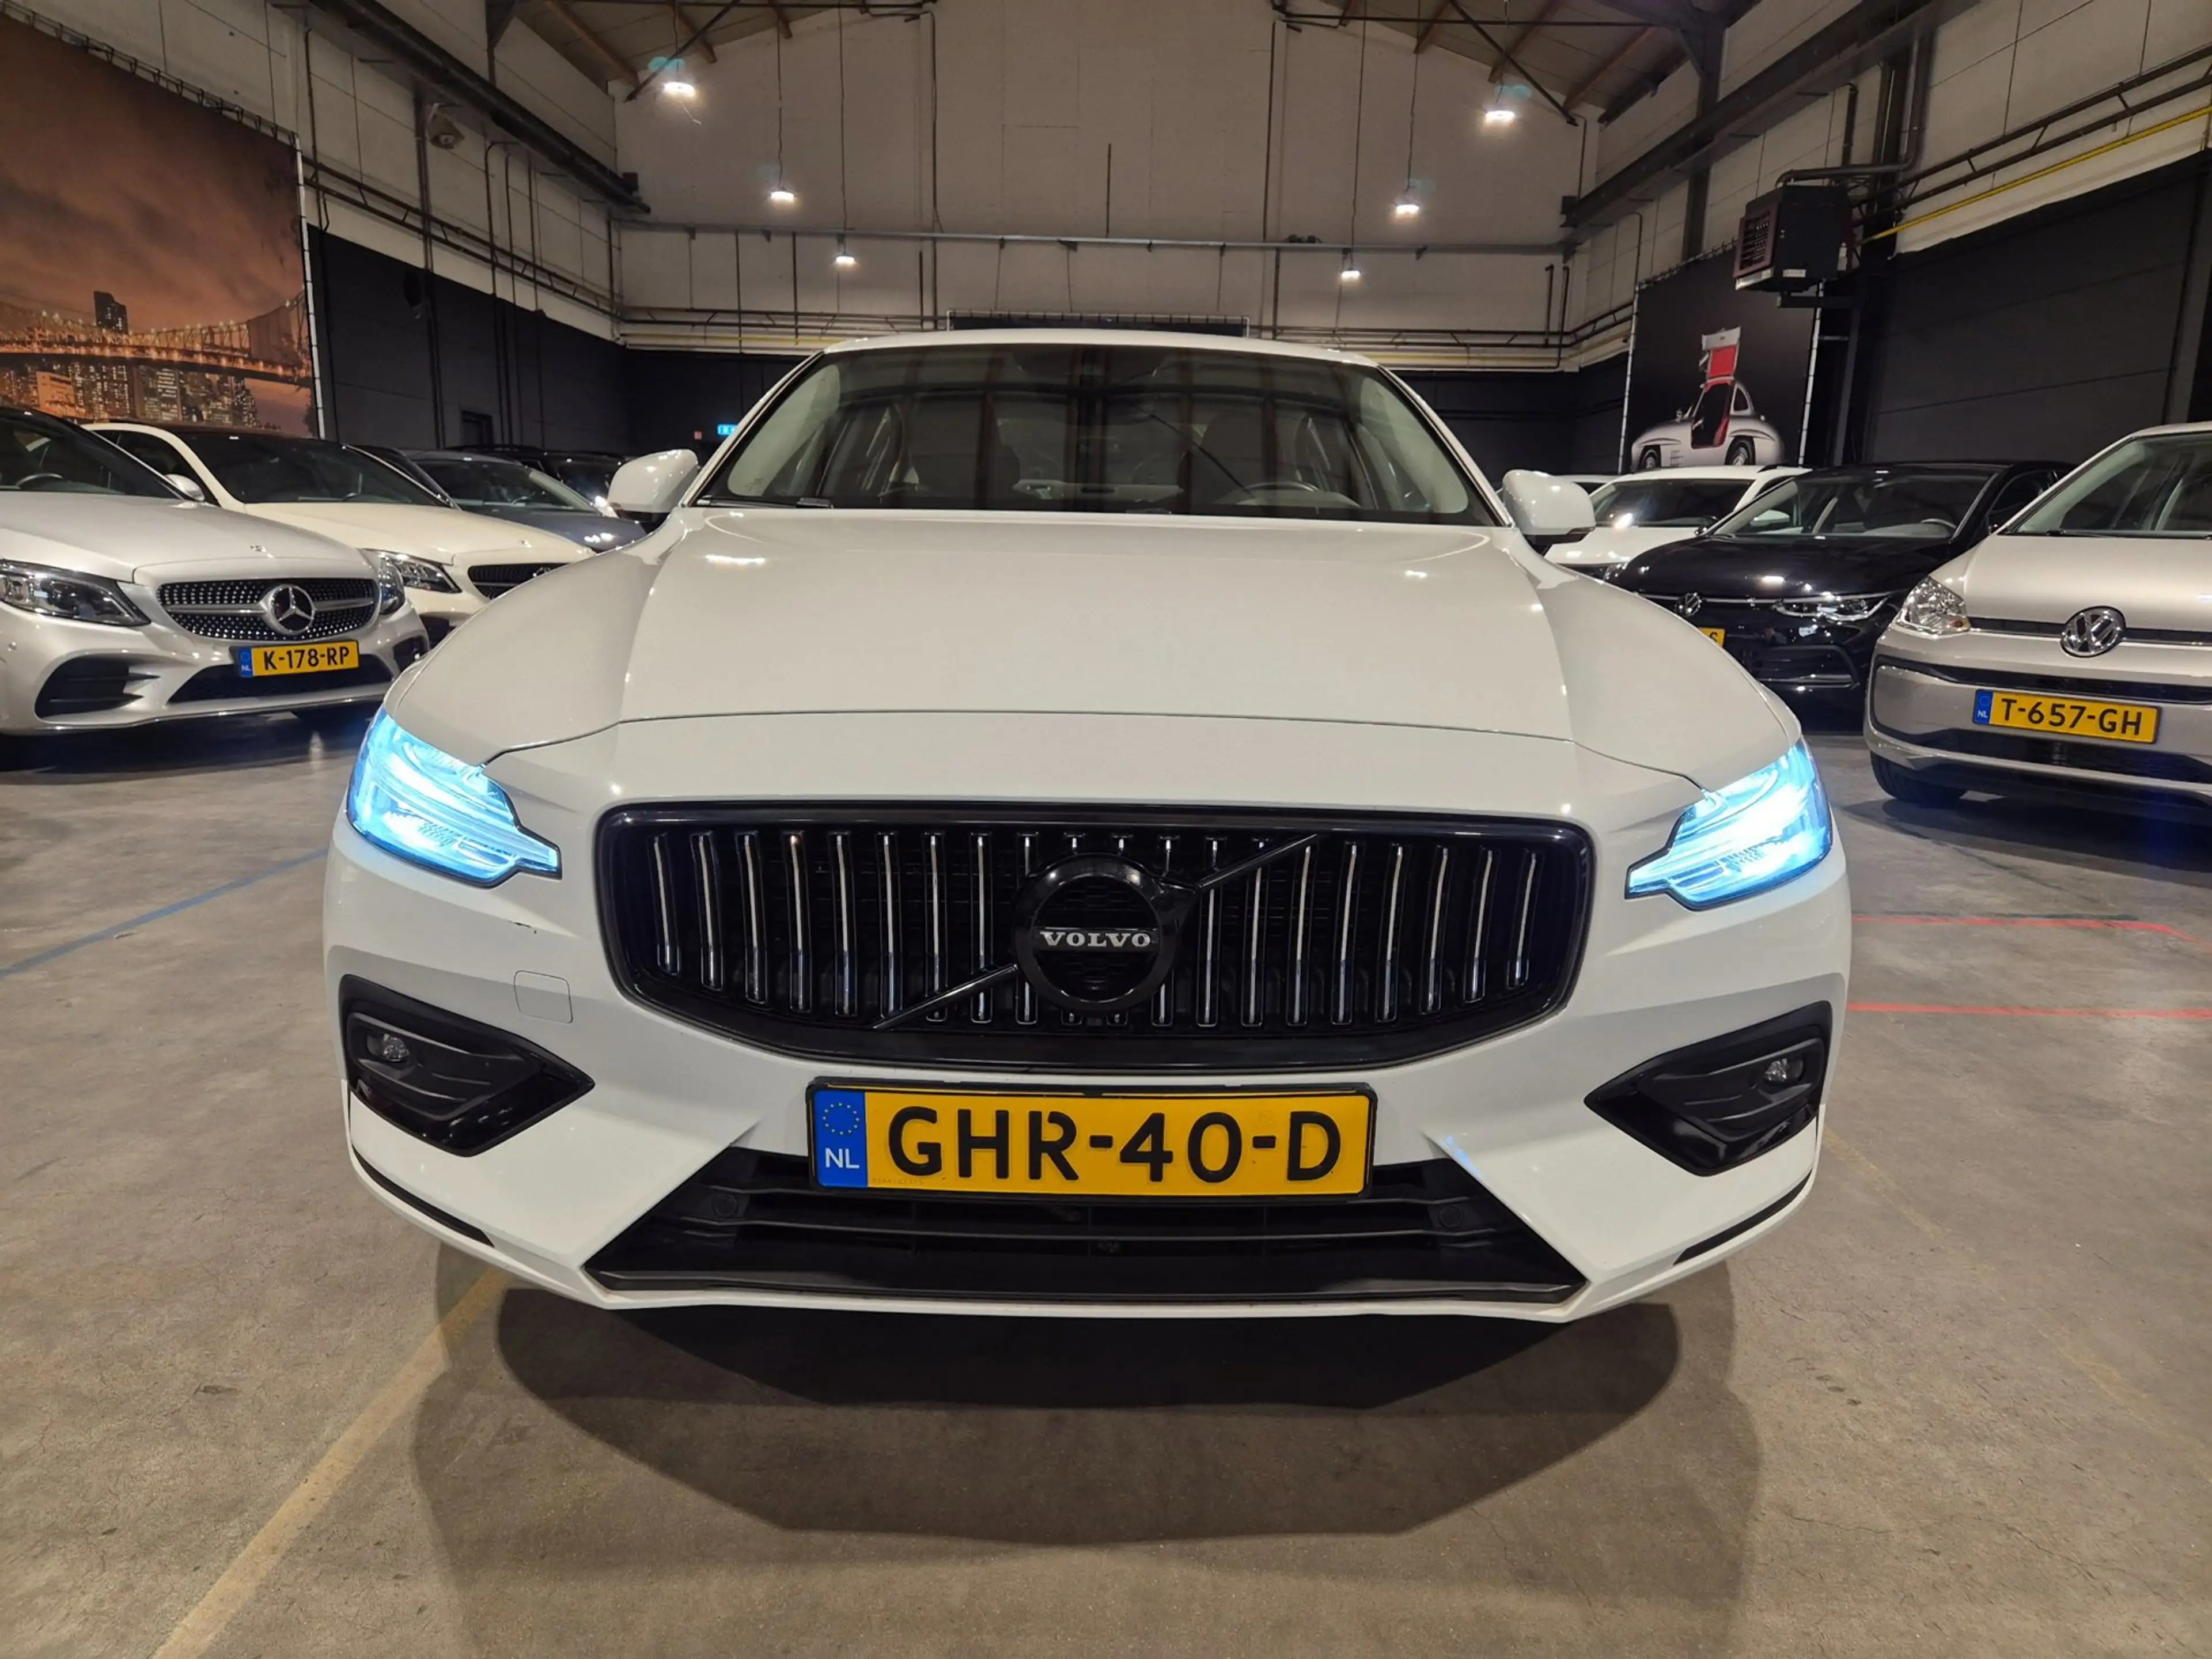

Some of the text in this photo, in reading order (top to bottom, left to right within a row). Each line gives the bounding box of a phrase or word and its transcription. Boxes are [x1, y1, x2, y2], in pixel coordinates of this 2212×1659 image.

[263, 646, 350, 671] K-178-RP
[1976, 698, 2143, 736] NL T-657-GH
[1039, 931, 1151, 948] VOLVO
[825, 1106, 1342, 1183] NL GHR-40-D
